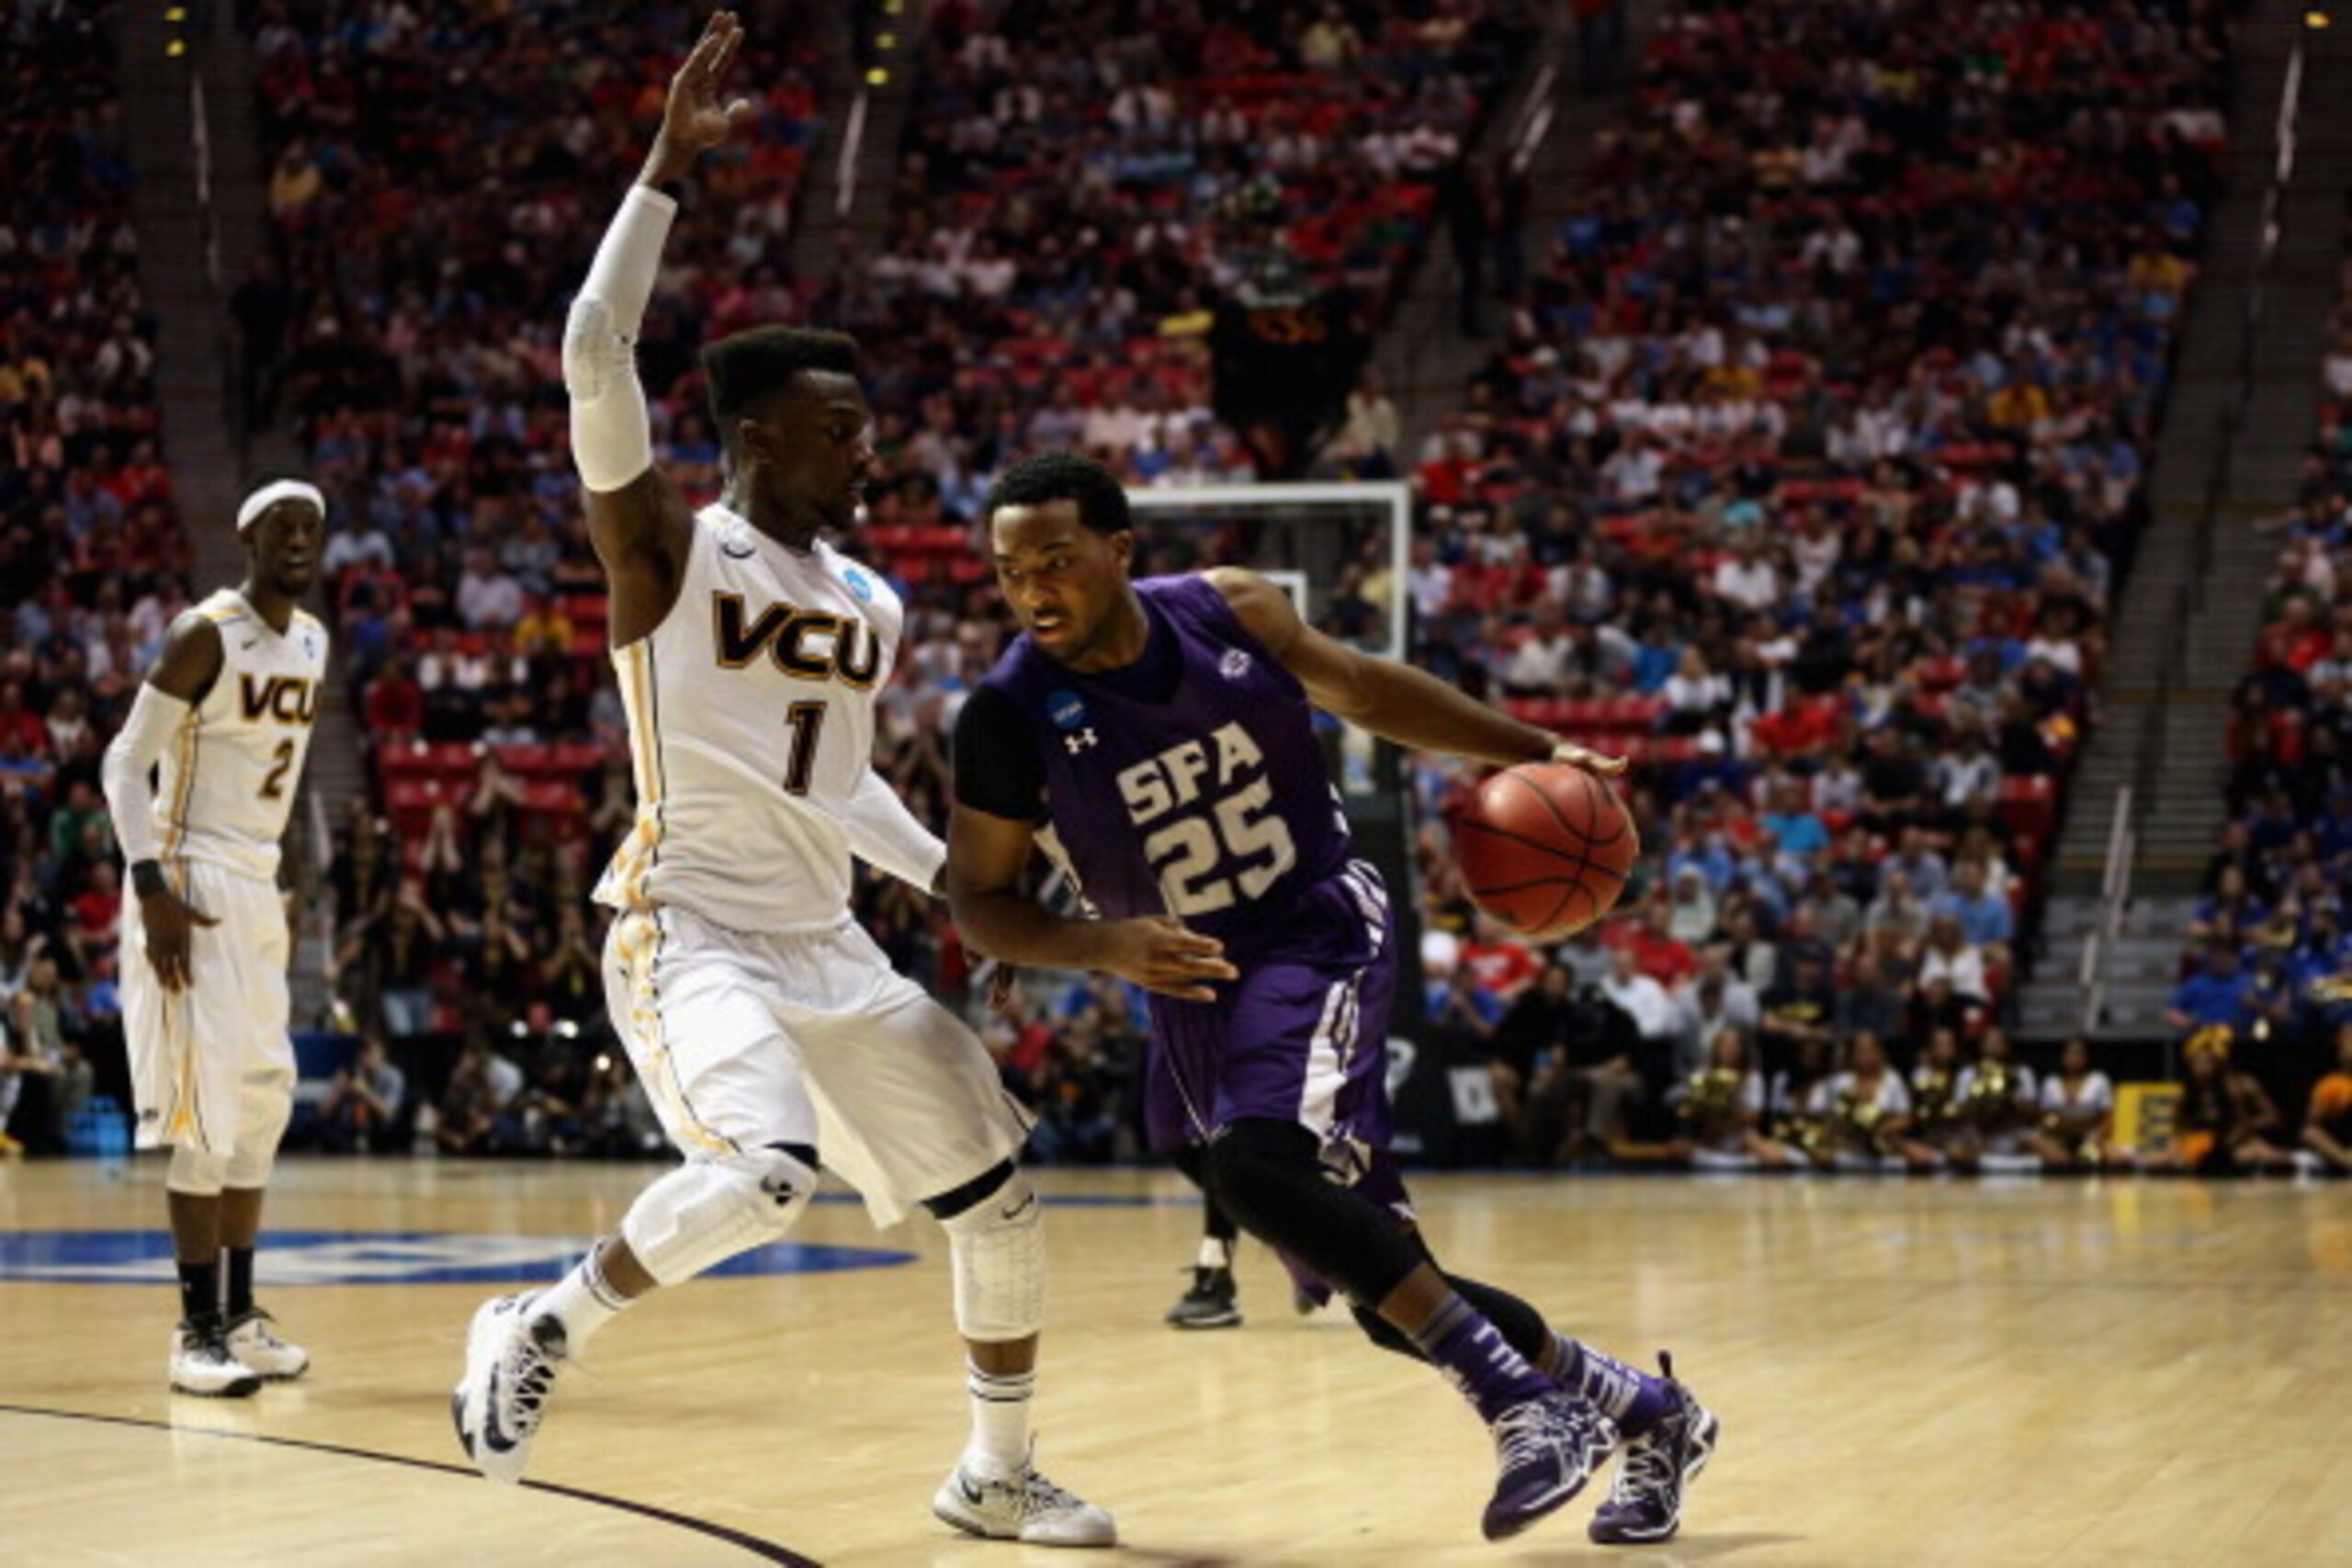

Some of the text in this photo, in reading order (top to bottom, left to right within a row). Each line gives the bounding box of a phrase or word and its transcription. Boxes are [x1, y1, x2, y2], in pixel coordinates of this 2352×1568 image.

[712, 590, 879, 693] VCU
[240, 671, 319, 726] VCU
[784, 700, 828, 796] 1
[258, 738, 295, 799] 2
[1116, 721, 1264, 825] SFA
[1144, 773, 1296, 919] 25
